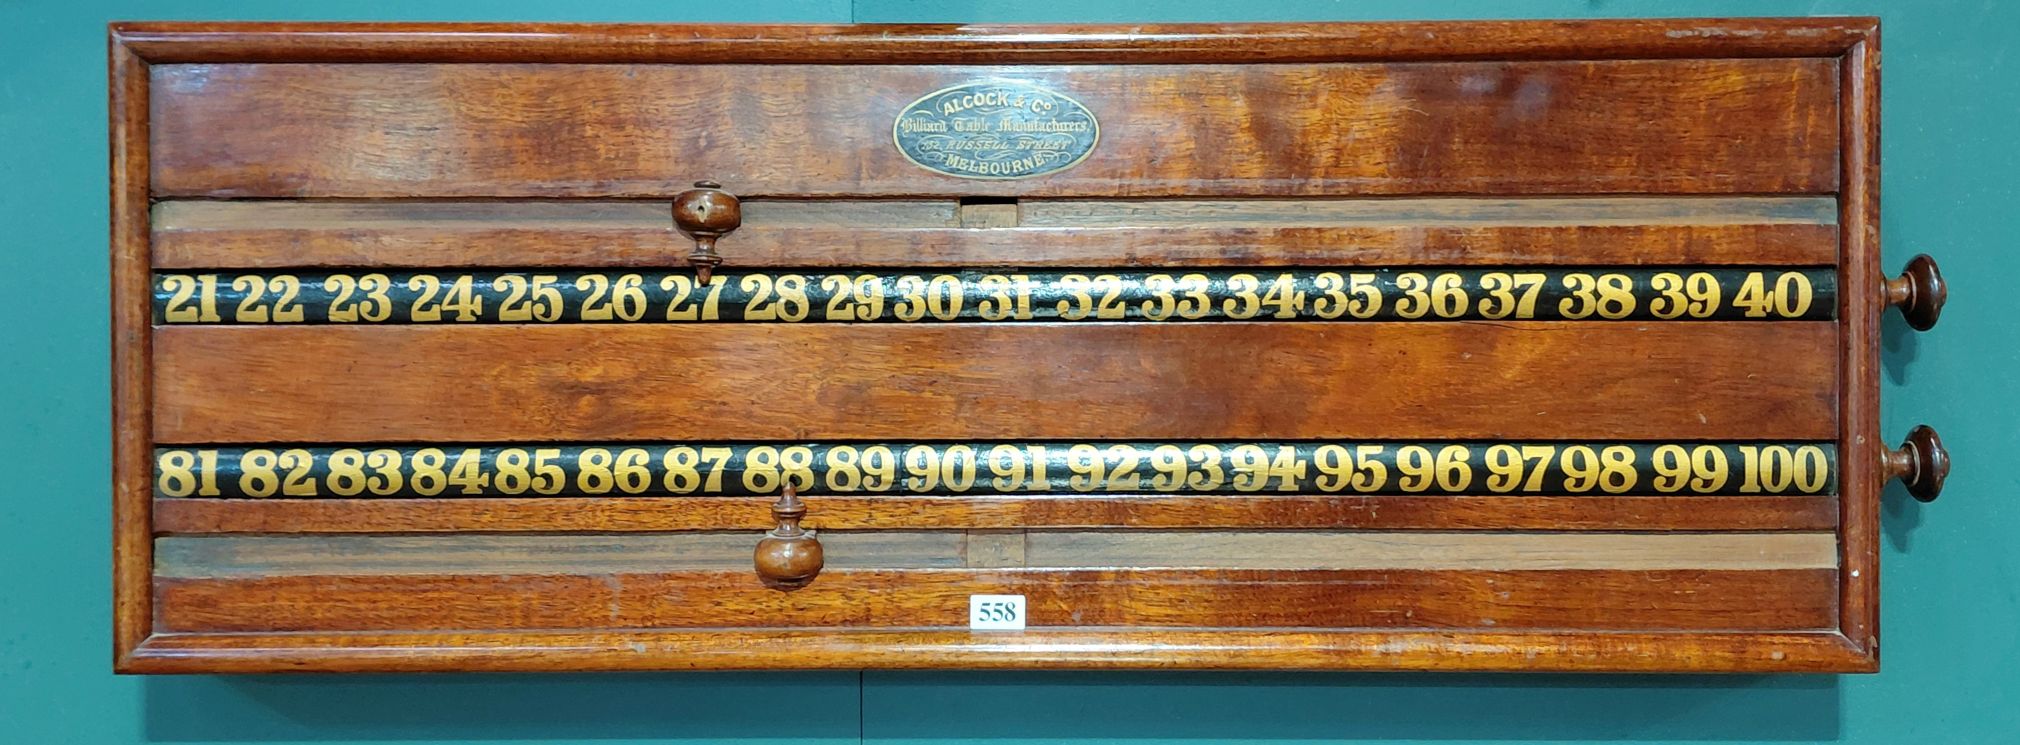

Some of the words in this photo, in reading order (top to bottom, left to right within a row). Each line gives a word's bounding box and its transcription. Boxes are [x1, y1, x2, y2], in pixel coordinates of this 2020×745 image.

[943, 91, 1009, 116] ALCOCK
[1013, 95, 1025, 108] &
[900, 117, 948, 137] Billiard
[952, 117, 992, 132] Table
[945, 140, 1010, 150] RUSSELL
[1015, 139, 1073, 150] STREET
[163, 275, 221, 321] 21
[232, 275, 304, 322] 22
[323, 274, 393, 321] 23
[408, 275, 482, 321] 24
[491, 275, 564, 321] 25
[576, 274, 647, 321] 26
[660, 275, 728, 321] 27
[741, 274, 810, 322] 28
[821, 274, 885, 321] 29
[893, 274, 964, 322] 30
[978, 274, 1041, 320] 31
[1055, 274, 1126, 320] 32
[1140, 274, 1212, 321] 33
[1223, 274, 1306, 319] 34
[1314, 272, 1383, 319] 35
[1394, 273, 1469, 318] 36
[1479, 273, 1547, 318] 37
[1559, 273, 1637, 317] 38
[1650, 273, 1721, 318] 39
[1732, 272, 1813, 318] 40
[158, 450, 220, 497] 81
[239, 449, 317, 496] 82
[327, 449, 403, 495] 83
[411, 448, 490, 495] 84
[495, 449, 566, 494] 85
[578, 448, 652, 494] 86
[663, 447, 734, 493] 87
[742, 446, 815, 493] 88
[826, 446, 896, 493] 89
[904, 445, 977, 493] 90
[988, 445, 1053, 492] 91
[1068, 445, 1144, 493] 92
[1151, 445, 1225, 492] 93
[1231, 445, 1306, 492] 94
[1315, 445, 1388, 492] 95
[1397, 445, 1473, 492] 96
[1485, 445, 1556, 493] 97
[1561, 445, 1638, 492] 98
[1653, 445, 1729, 493] 99
[1738, 445, 1829, 493] 100
[979, 602, 1016, 622] 558
